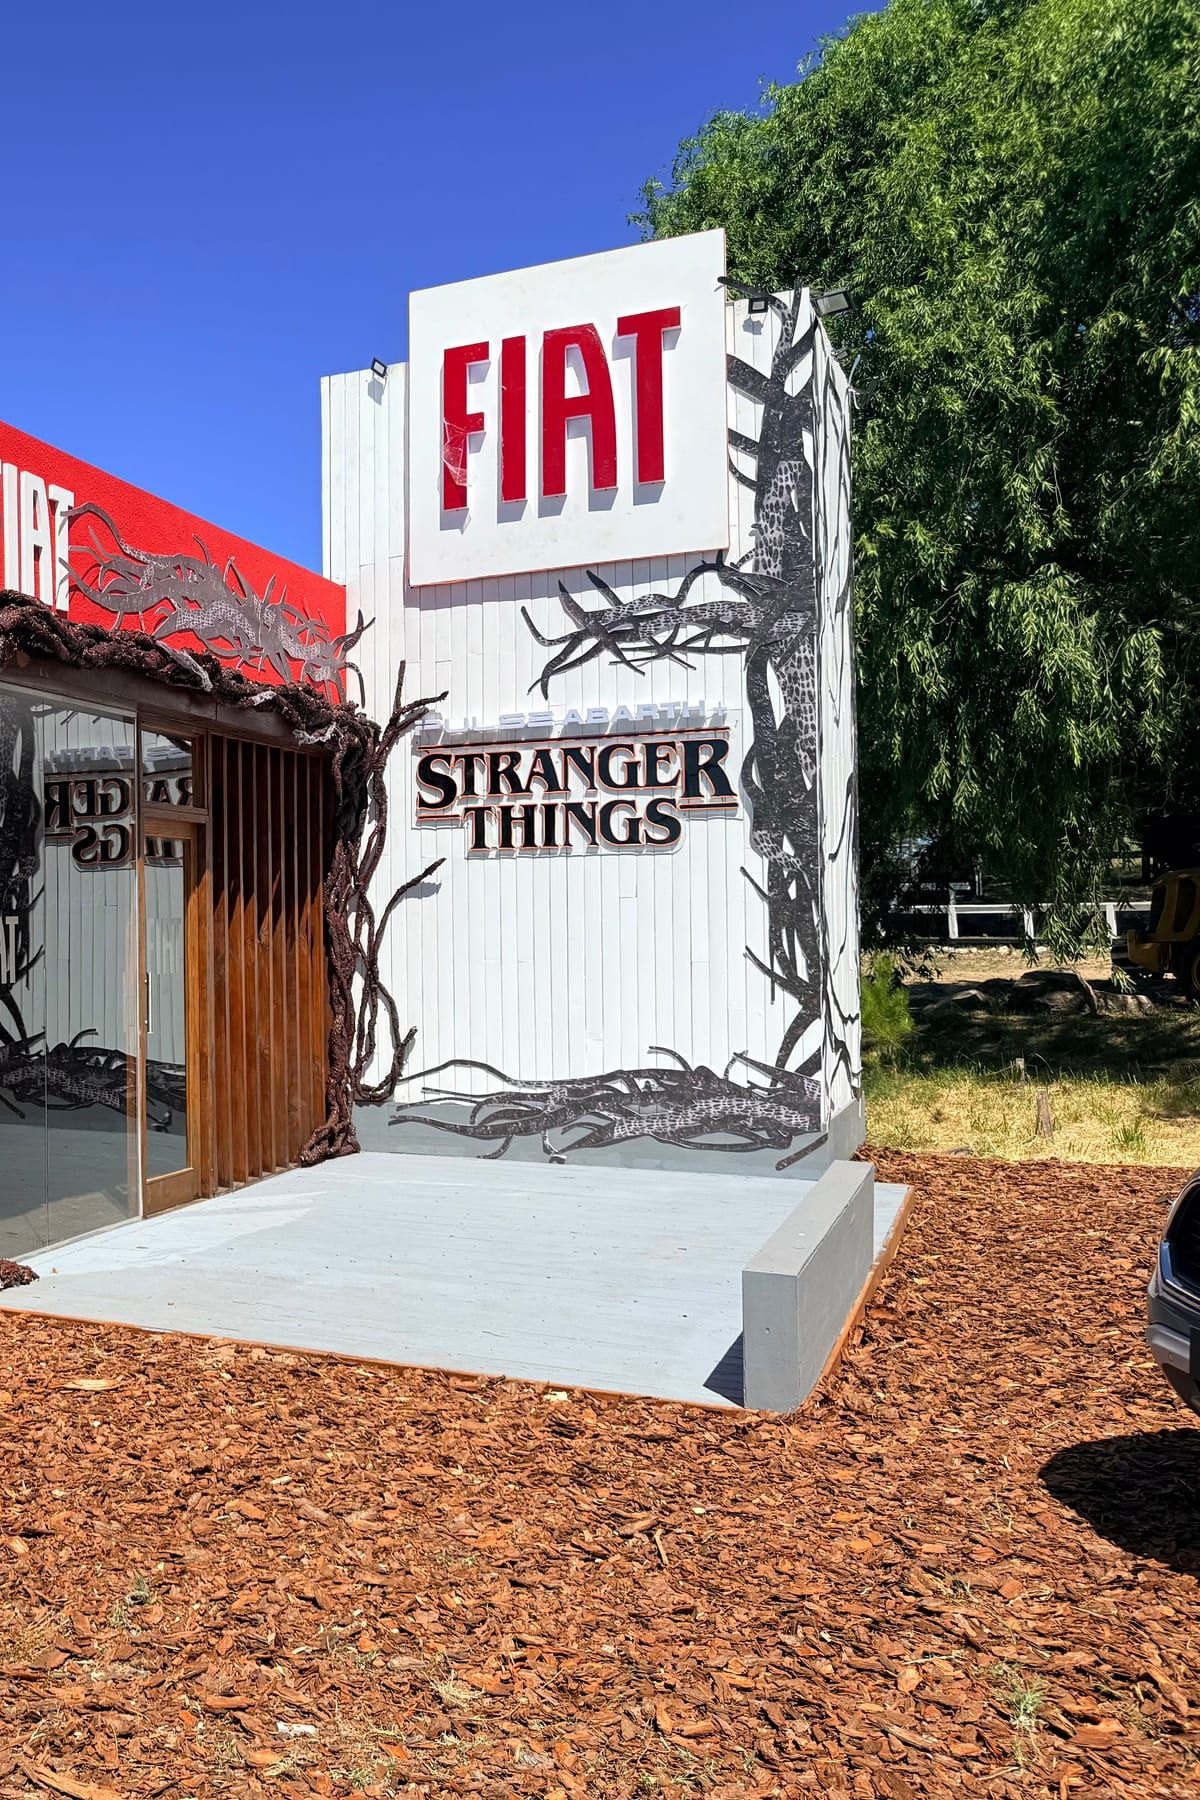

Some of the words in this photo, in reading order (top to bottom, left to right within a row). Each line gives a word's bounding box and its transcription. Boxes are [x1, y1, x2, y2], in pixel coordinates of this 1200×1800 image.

[443, 306, 681, 511] FIAT
[562, 700, 705, 726] ABARTH
[416, 738, 737, 809] STRANGER
[464, 798, 682, 850] THINGS
